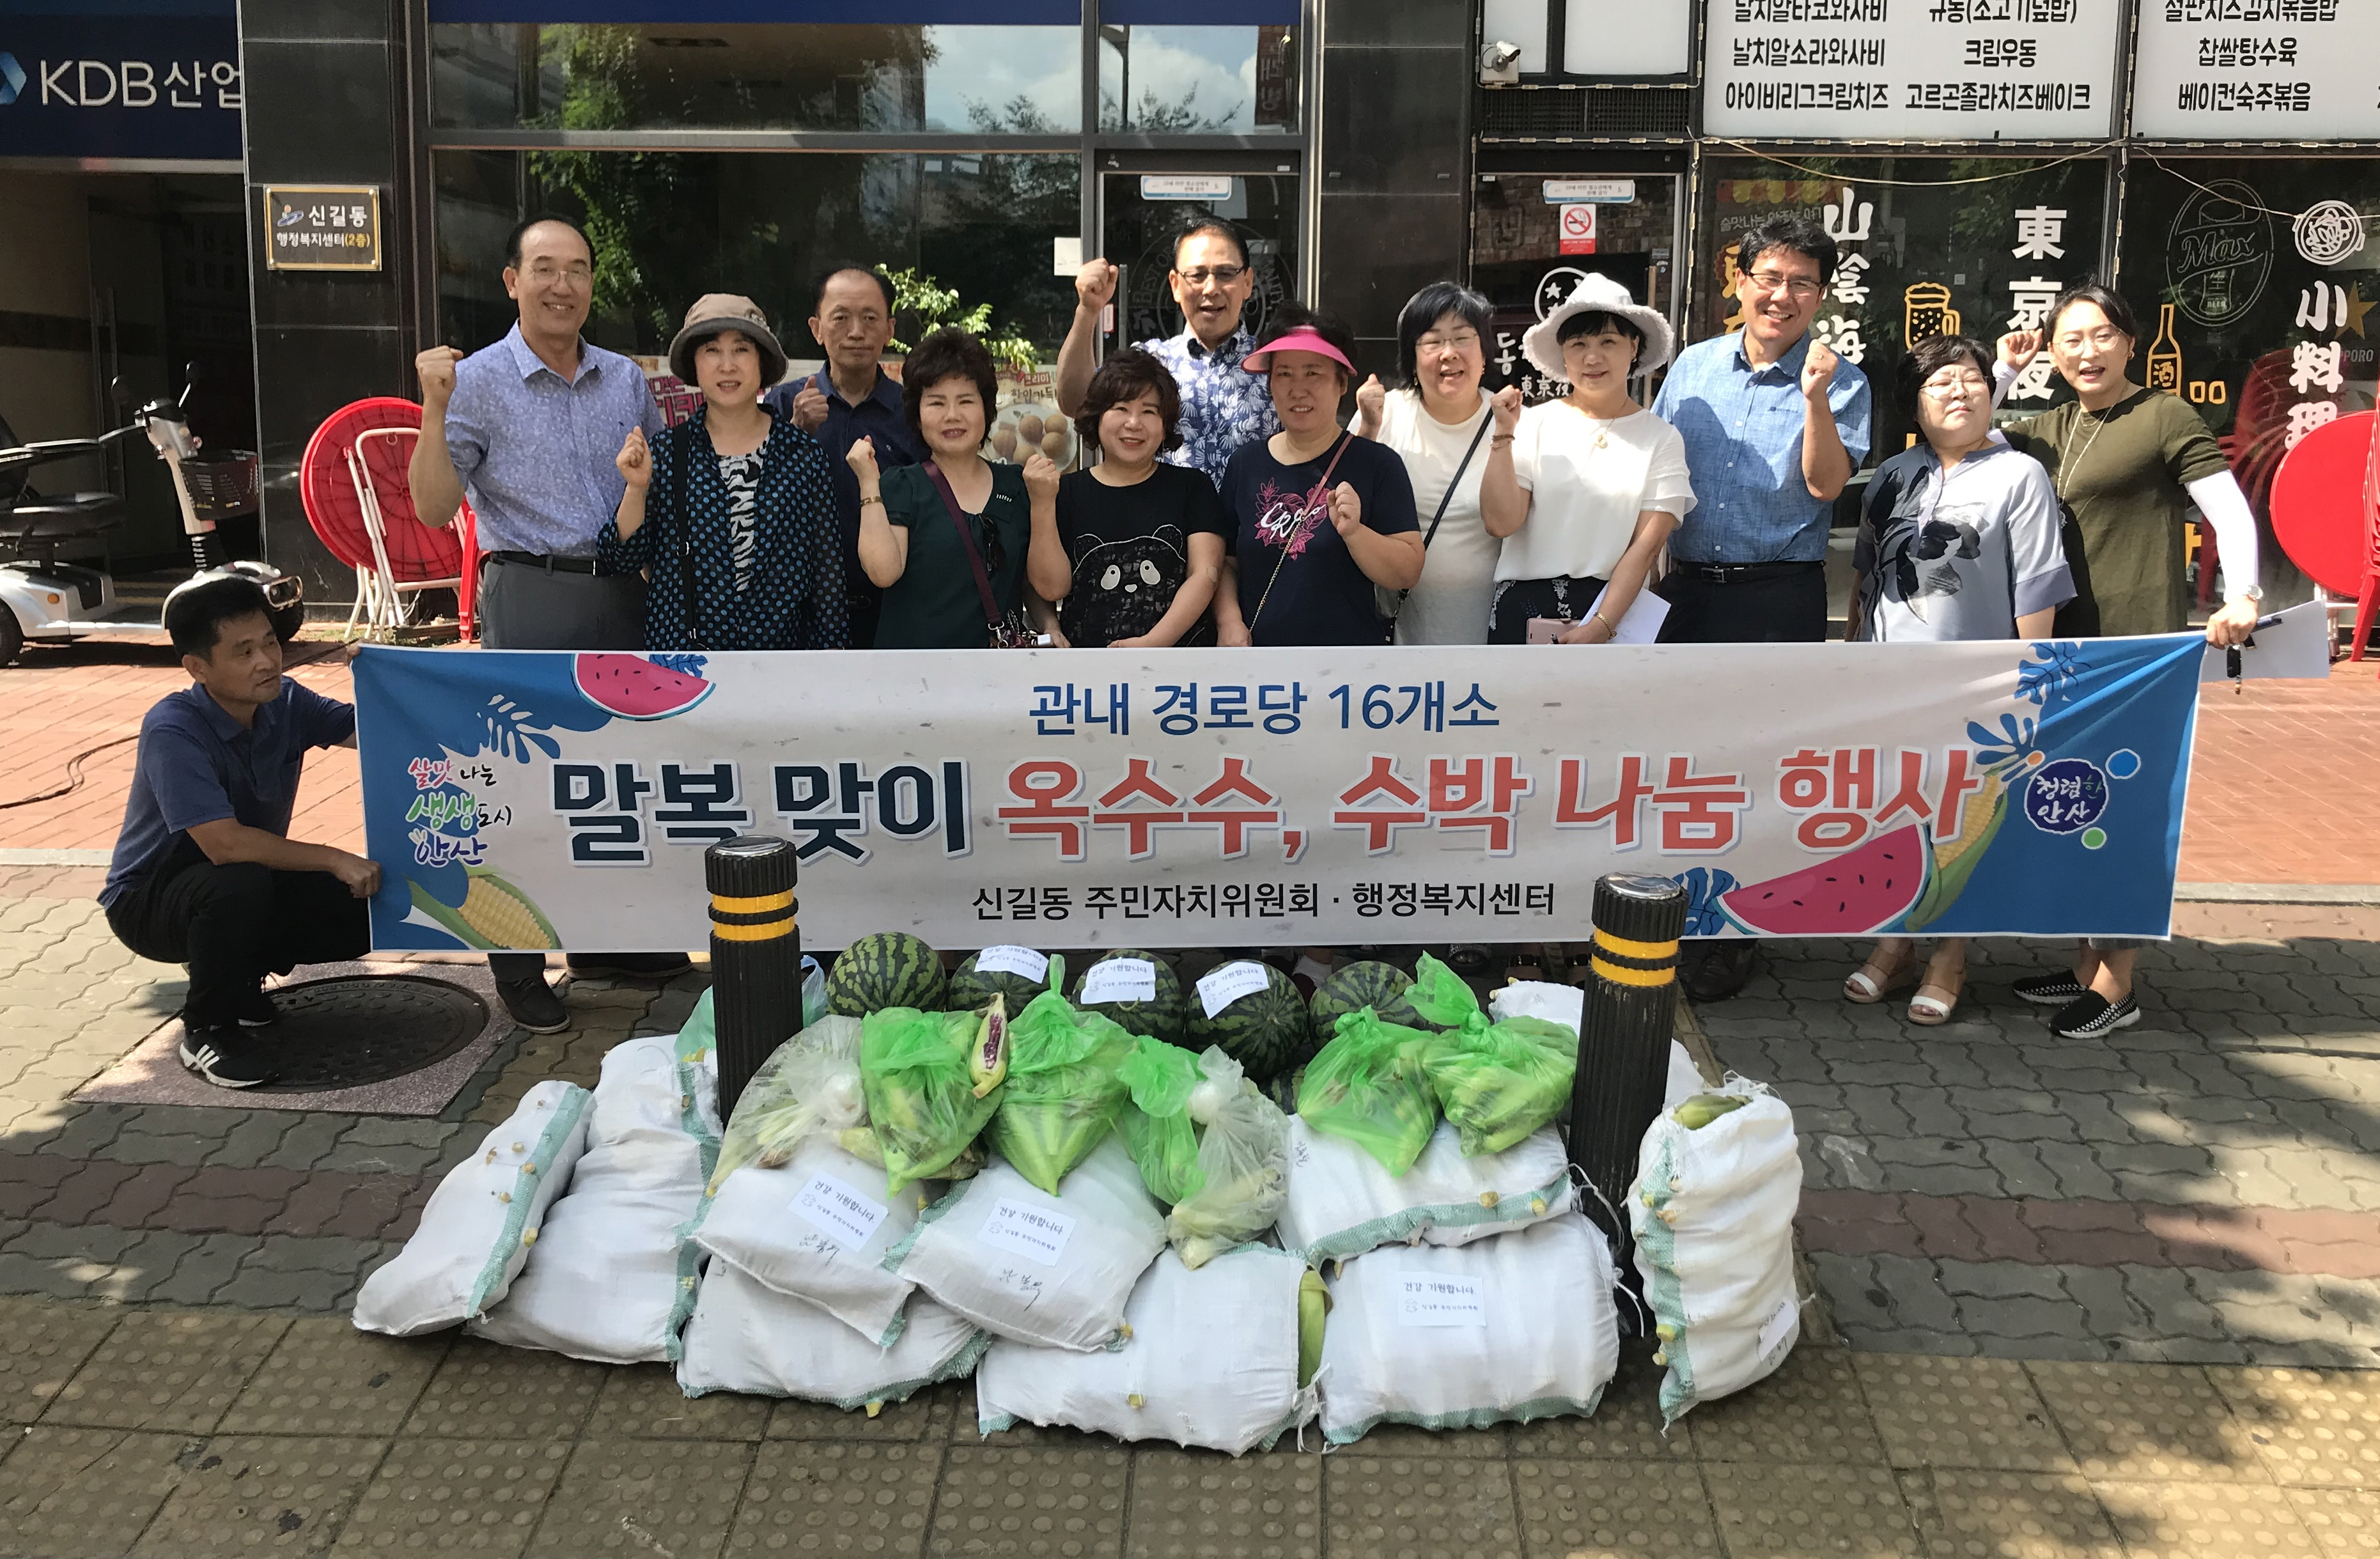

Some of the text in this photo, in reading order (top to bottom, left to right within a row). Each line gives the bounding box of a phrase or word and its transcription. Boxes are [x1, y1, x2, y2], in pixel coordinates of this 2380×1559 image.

[1734, 37, 1885, 66] 날치알소라와사비
[1964, 39, 2036, 67] 크림우동
[2198, 37, 2298, 66] 찹쌀탕수육
[1726, 82, 1888, 111] 아이비리그크림치즈
[1905, 82, 2090, 111] 고르곤졸라치즈베이크
[2178, 82, 2311, 111] 베이컨숙주볶음
[309, 205, 368, 228] 신길동
[277, 231, 370, 247] 행정복지센터(2층)
[2177, 230, 2256, 274] Max
[2153, 361, 2174, 387] 酒
[1029, 680, 1500, 736] 관내 경로당 16개소
[552, 748, 1979, 862] 말복 맞이 옥수수, 수박 나눔 행사
[2037, 800, 2090, 825] 안산
[416, 835, 488, 866] 안산
[972, 887, 1073, 920] 신길동
[1084, 883, 1319, 920] 주민자치위원회
[1352, 881, 1555, 918] 행정복지센터
[814, 1181, 832, 1195] 건강
[999, 1206, 1016, 1218] 건강
[1404, 1281, 1422, 1292] 건강
